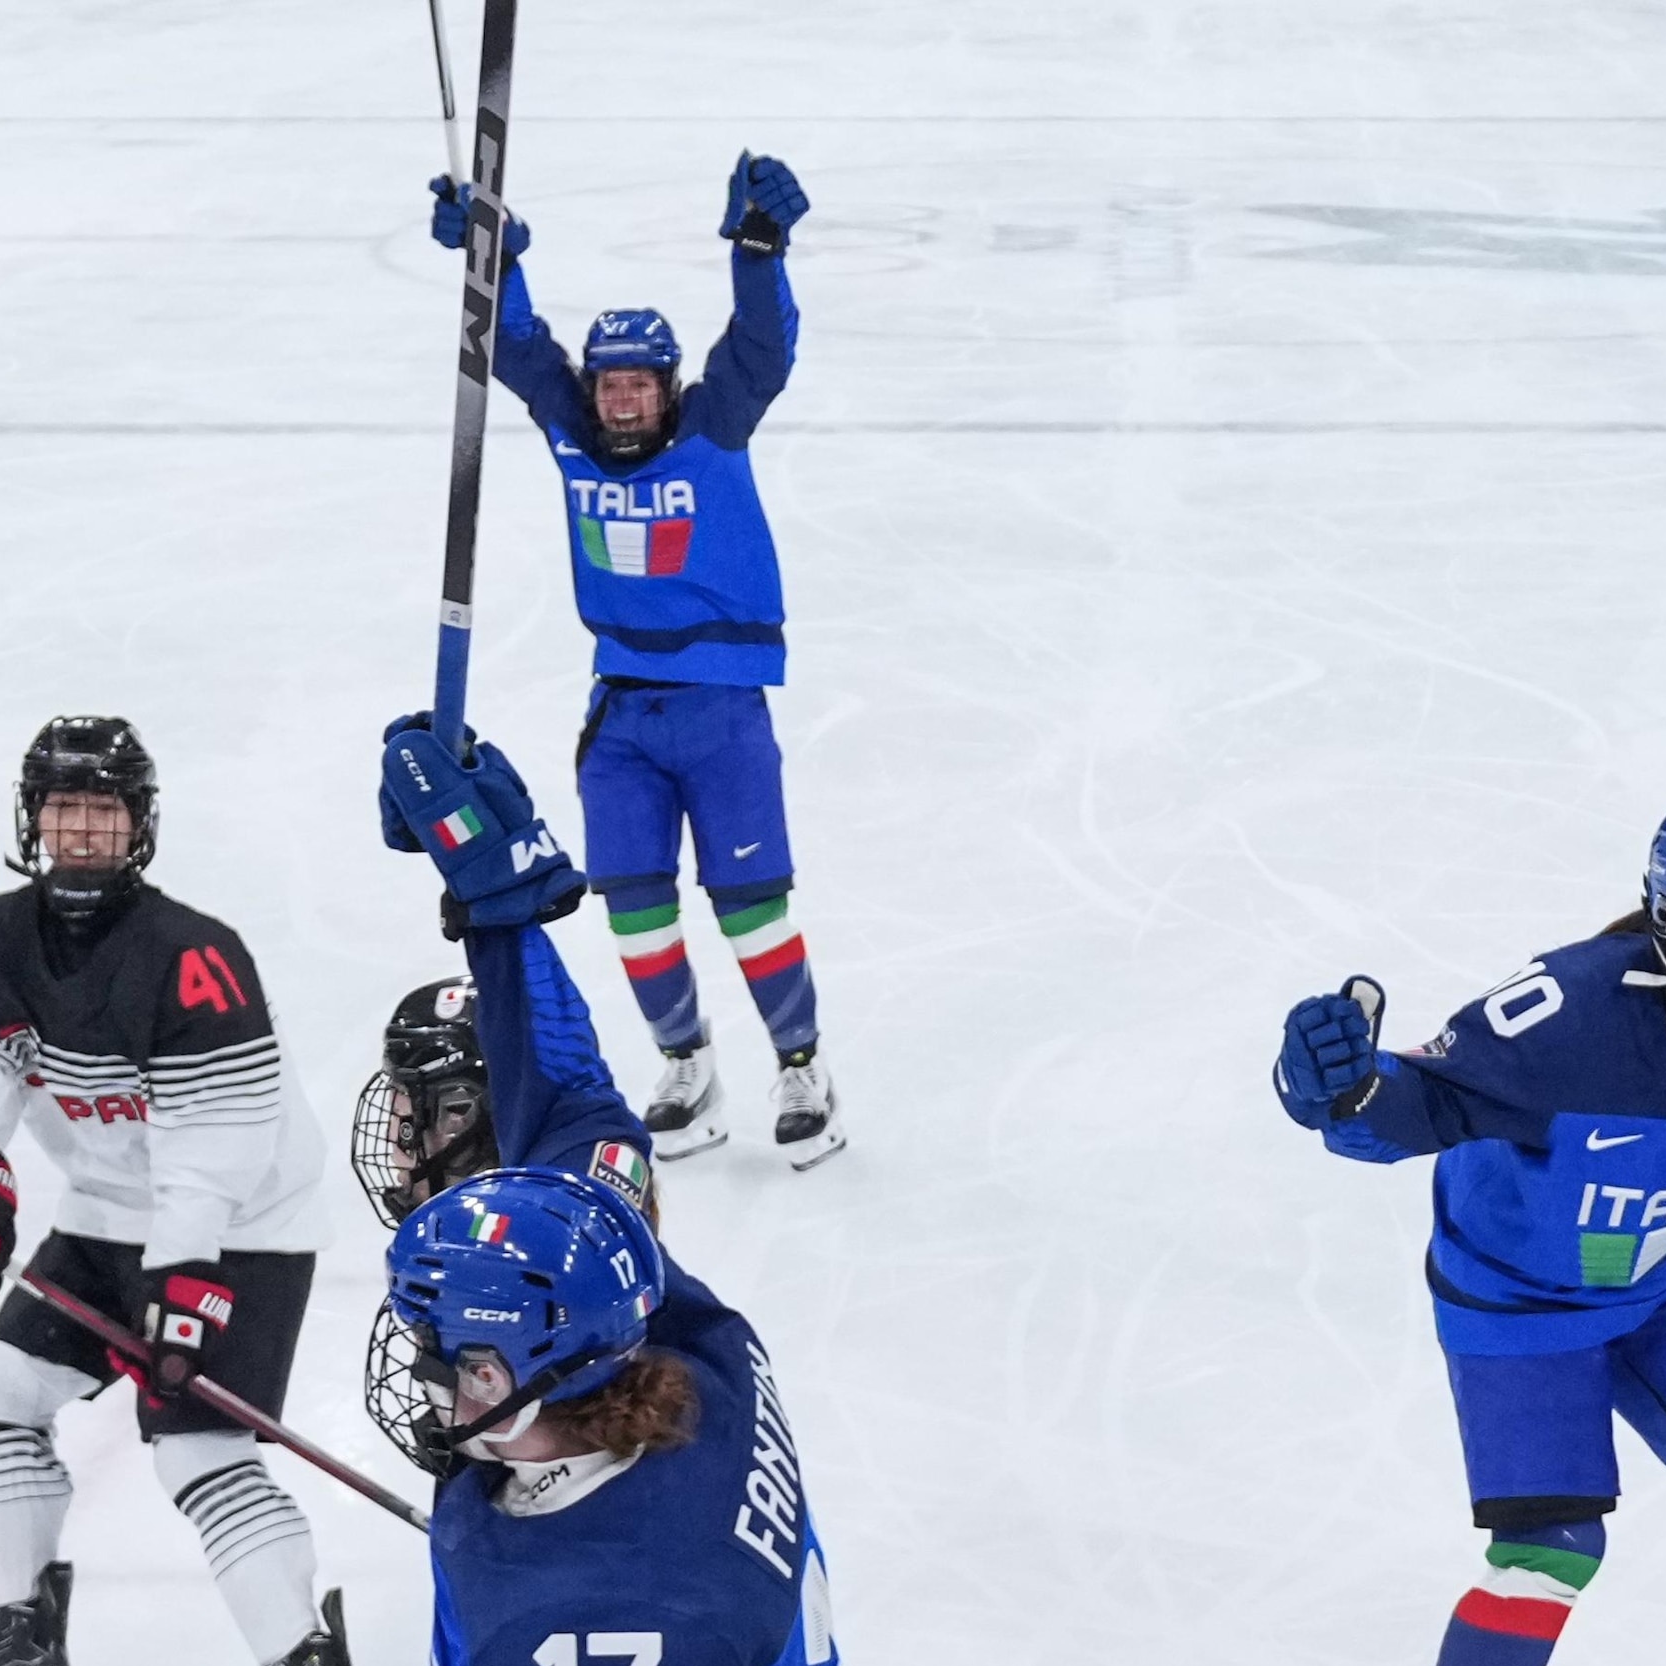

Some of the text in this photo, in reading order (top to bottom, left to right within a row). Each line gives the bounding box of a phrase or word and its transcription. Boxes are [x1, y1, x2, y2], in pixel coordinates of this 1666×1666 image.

[570, 478, 696, 518] TALIA
[399, 747, 432, 793] CCM
[177, 945, 249, 1014] 41
[609, 1247, 637, 1290] 17
[461, 1306, 522, 1323] CCM
